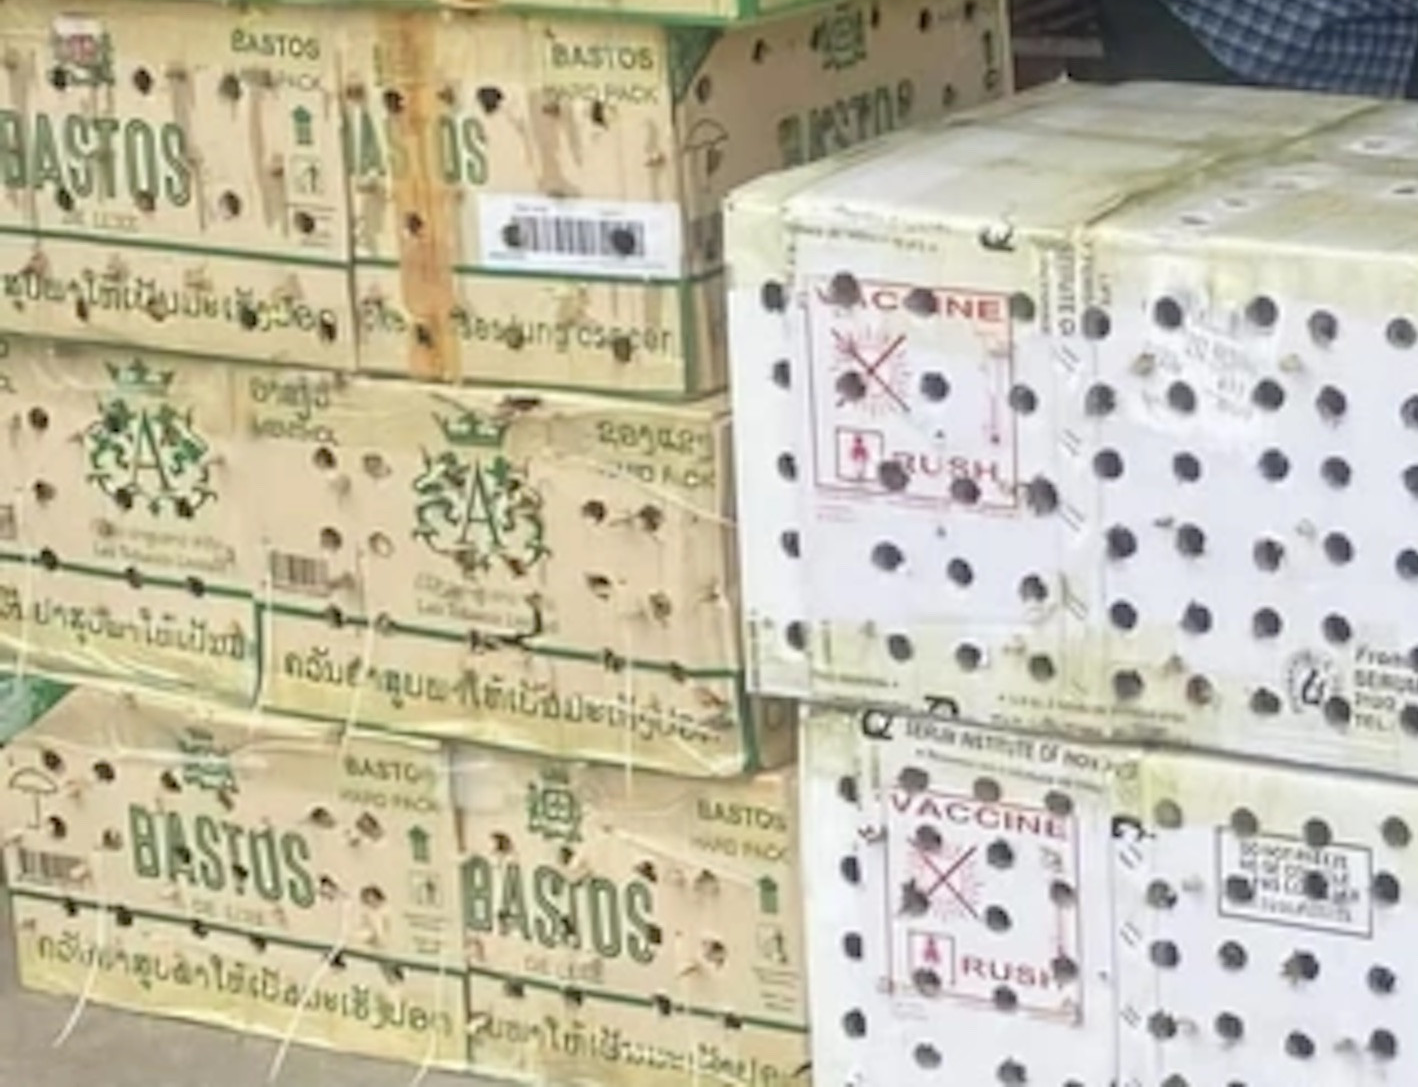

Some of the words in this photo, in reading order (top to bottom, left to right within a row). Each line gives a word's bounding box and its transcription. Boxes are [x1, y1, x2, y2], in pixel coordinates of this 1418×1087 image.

[231, 27, 321, 62] BASTOS
[551, 41, 654, 71] BASTOS
[891, 792, 1069, 841] VACCINE
[128, 803, 318, 910] BASTOS
[458, 853, 665, 965] BASTOS
